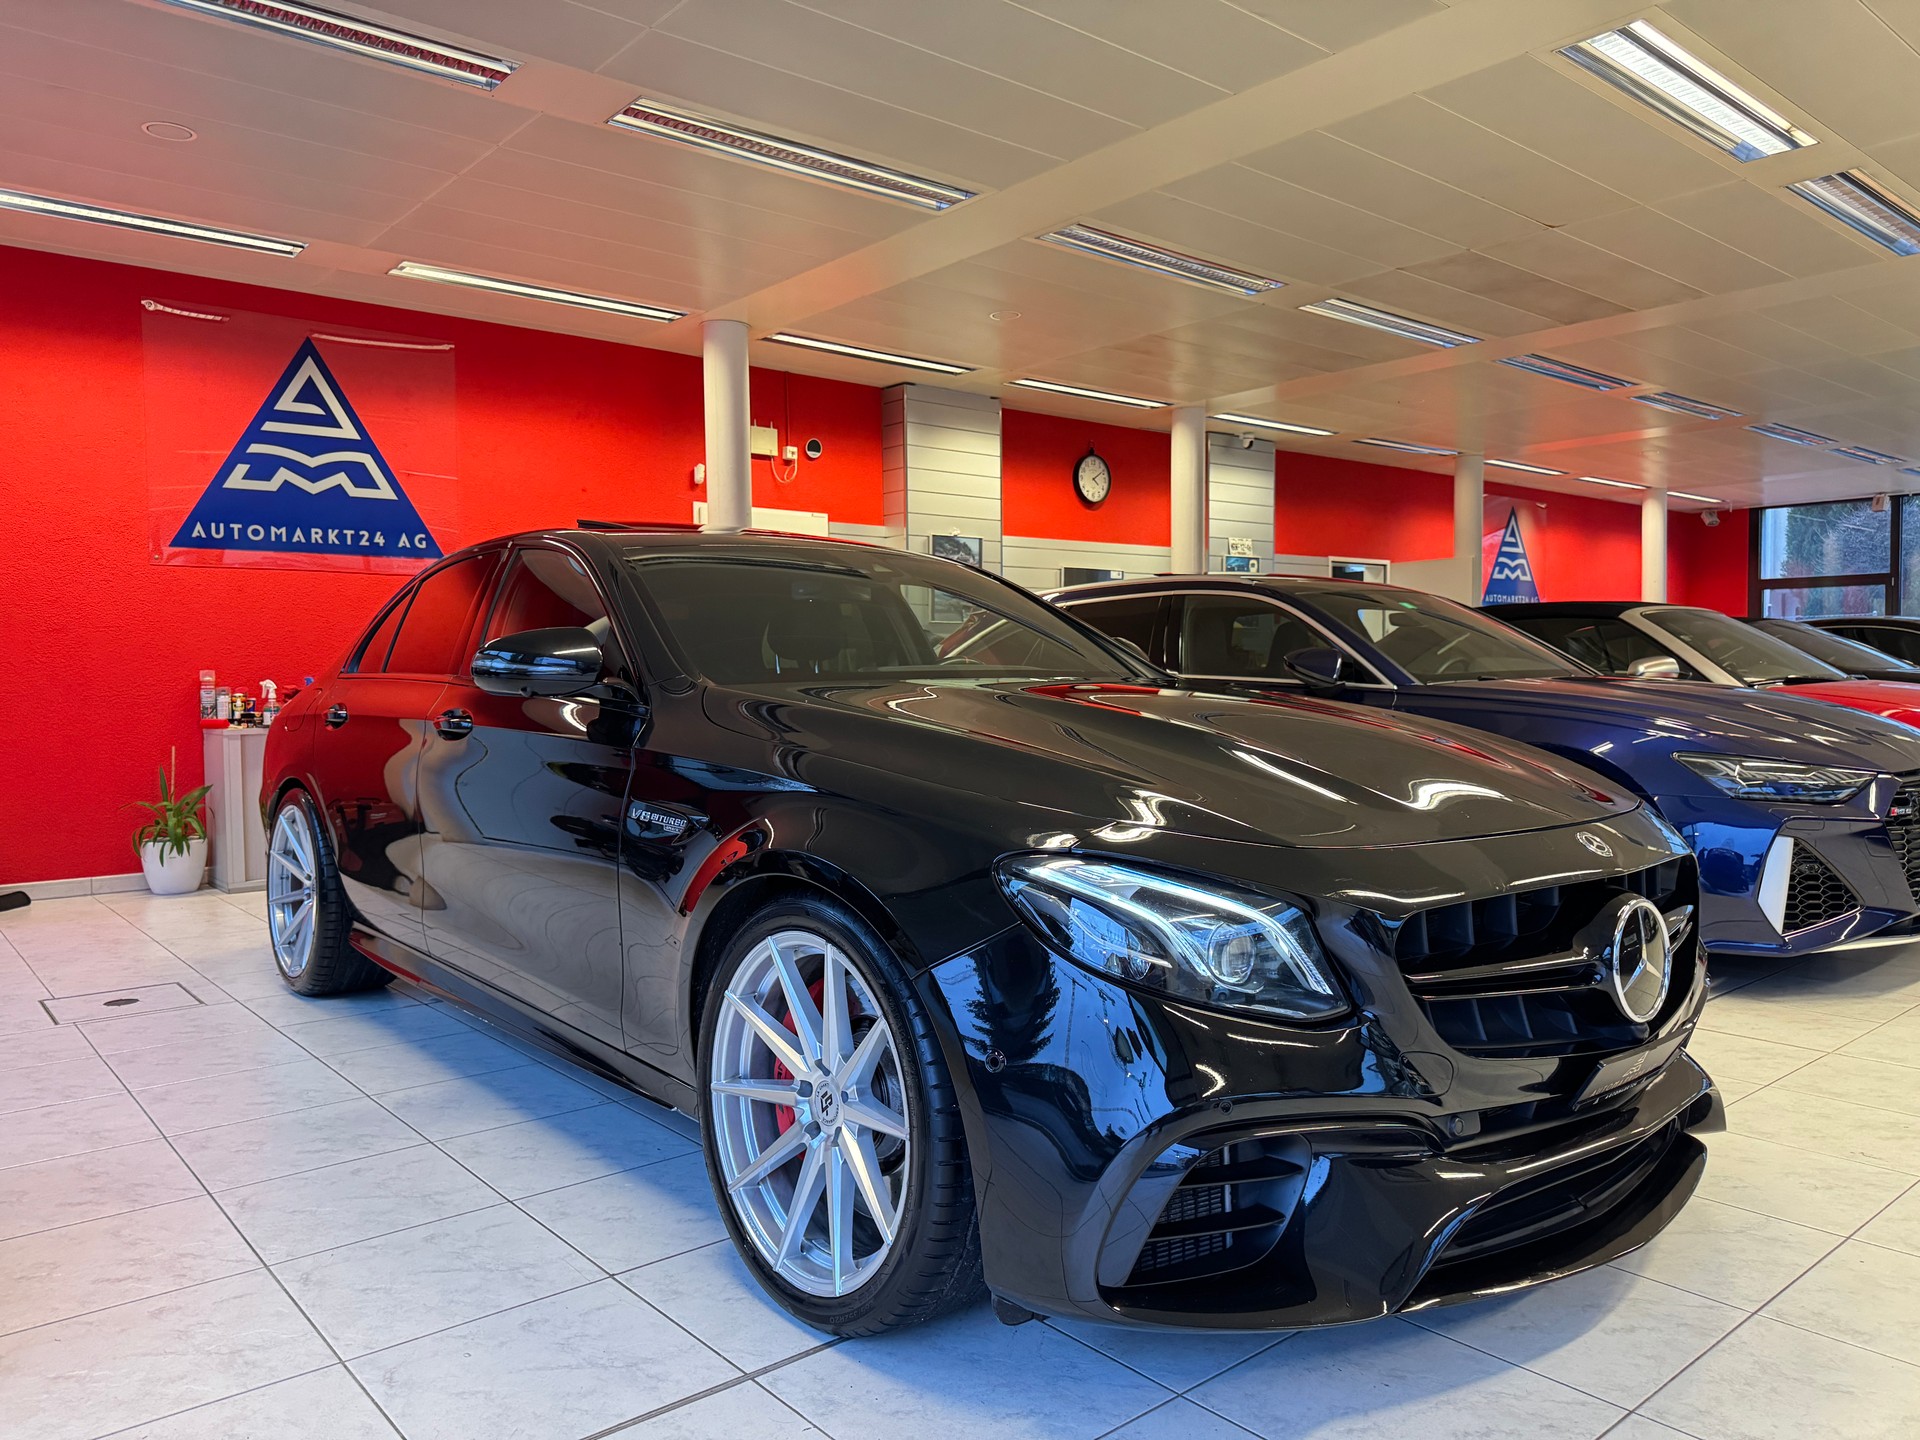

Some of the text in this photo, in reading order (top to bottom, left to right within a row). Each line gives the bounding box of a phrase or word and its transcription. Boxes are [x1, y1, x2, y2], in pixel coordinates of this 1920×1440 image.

[191, 520, 427, 549] AUTOMARKT24 AG
[631, 807, 687, 827] V8 BITURBO
